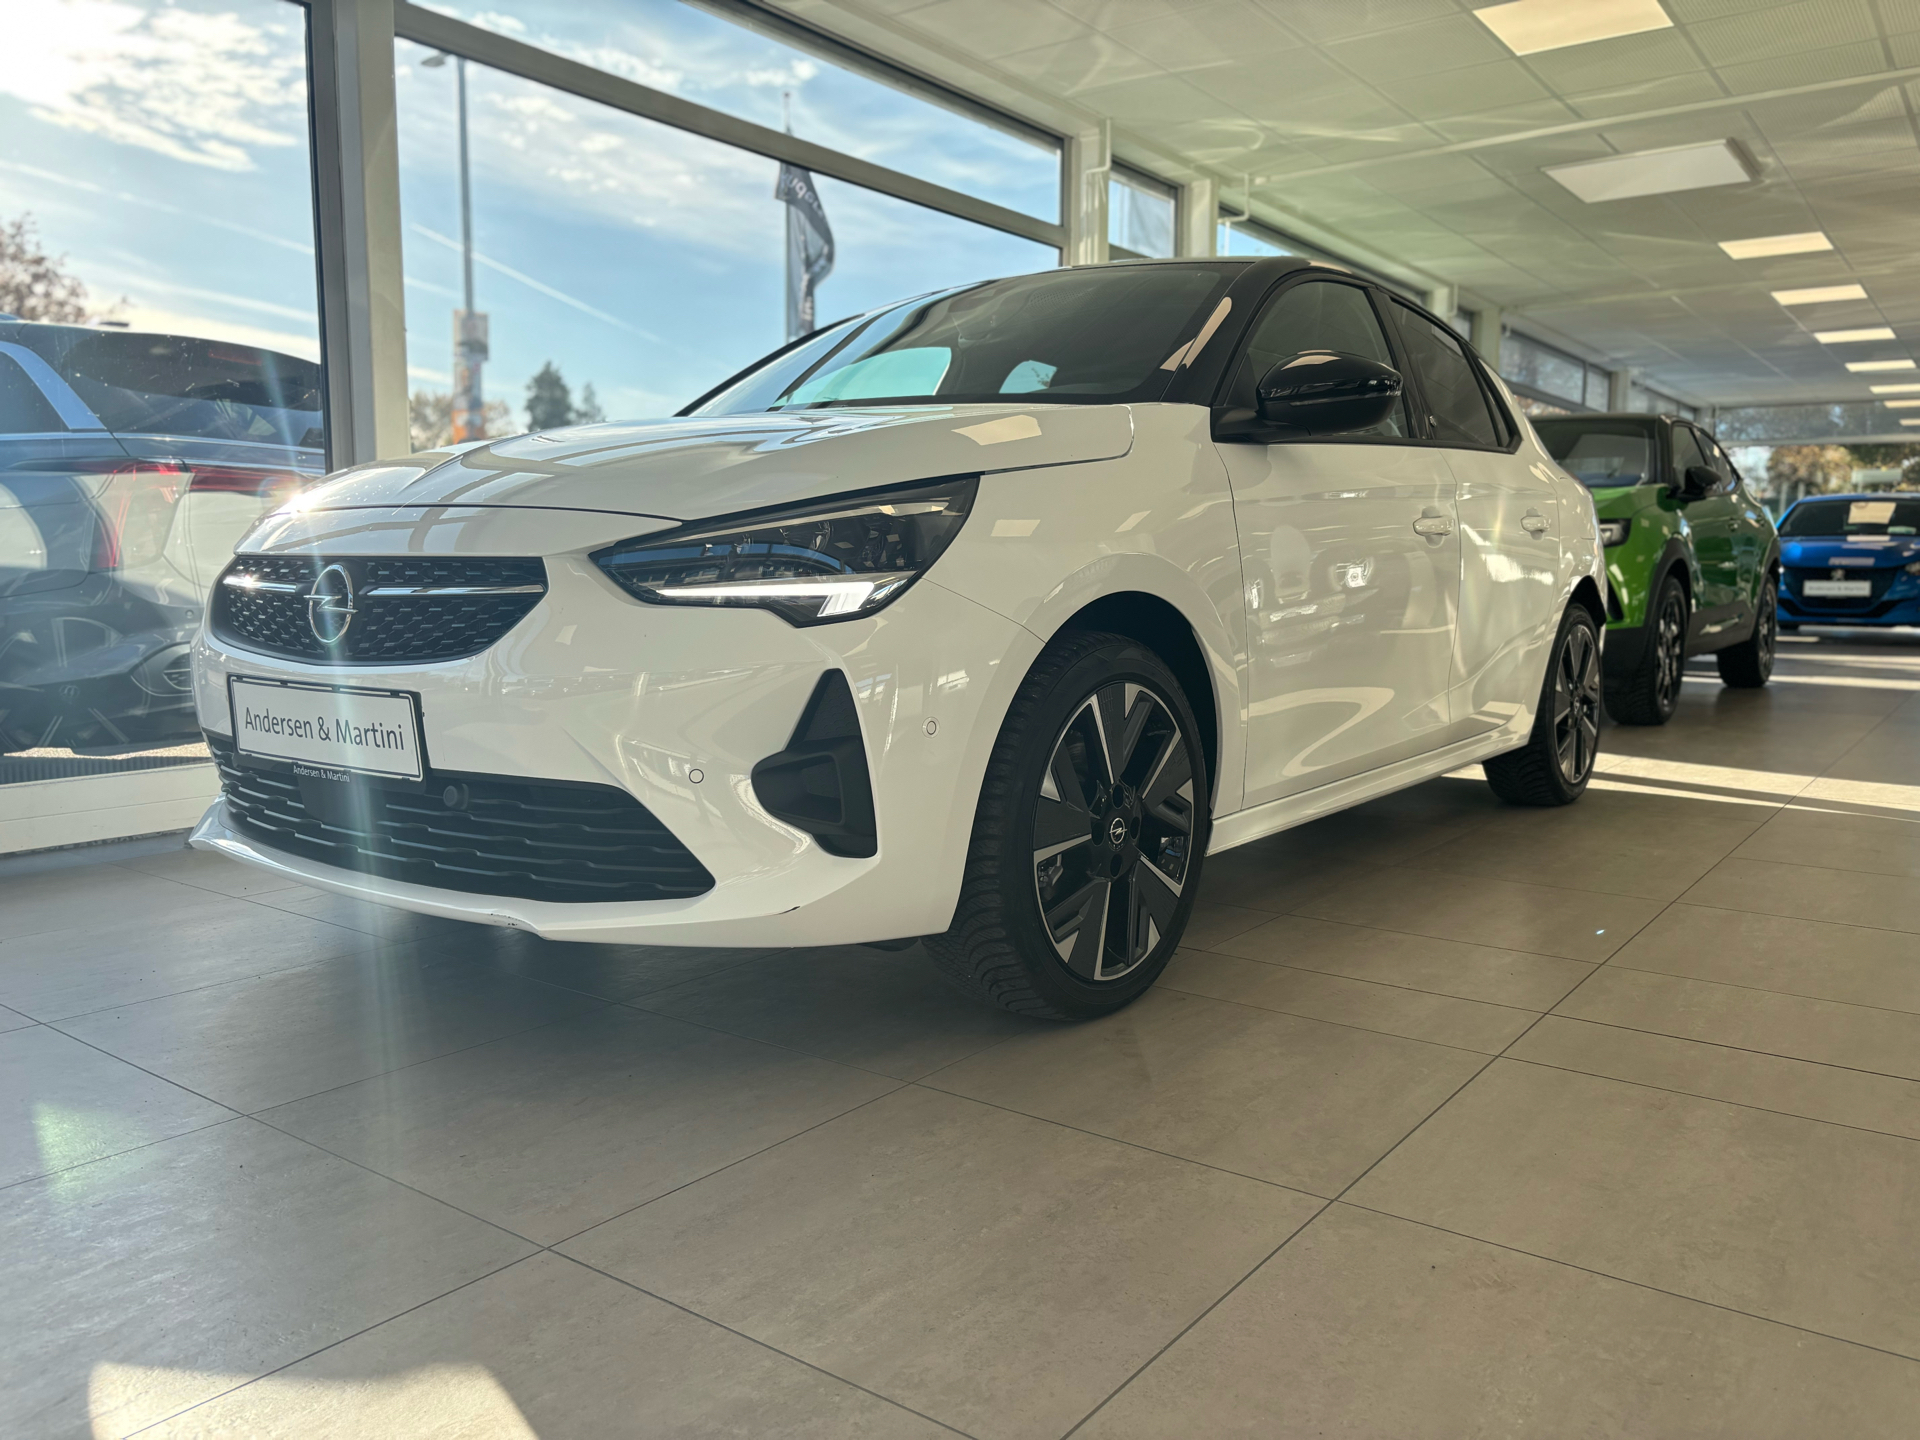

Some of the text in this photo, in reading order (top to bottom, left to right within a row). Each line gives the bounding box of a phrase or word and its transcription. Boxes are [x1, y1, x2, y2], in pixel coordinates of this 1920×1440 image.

[245, 707, 404, 750] Andersen & Martini
[293, 765, 350, 782] Andersen & Martini
